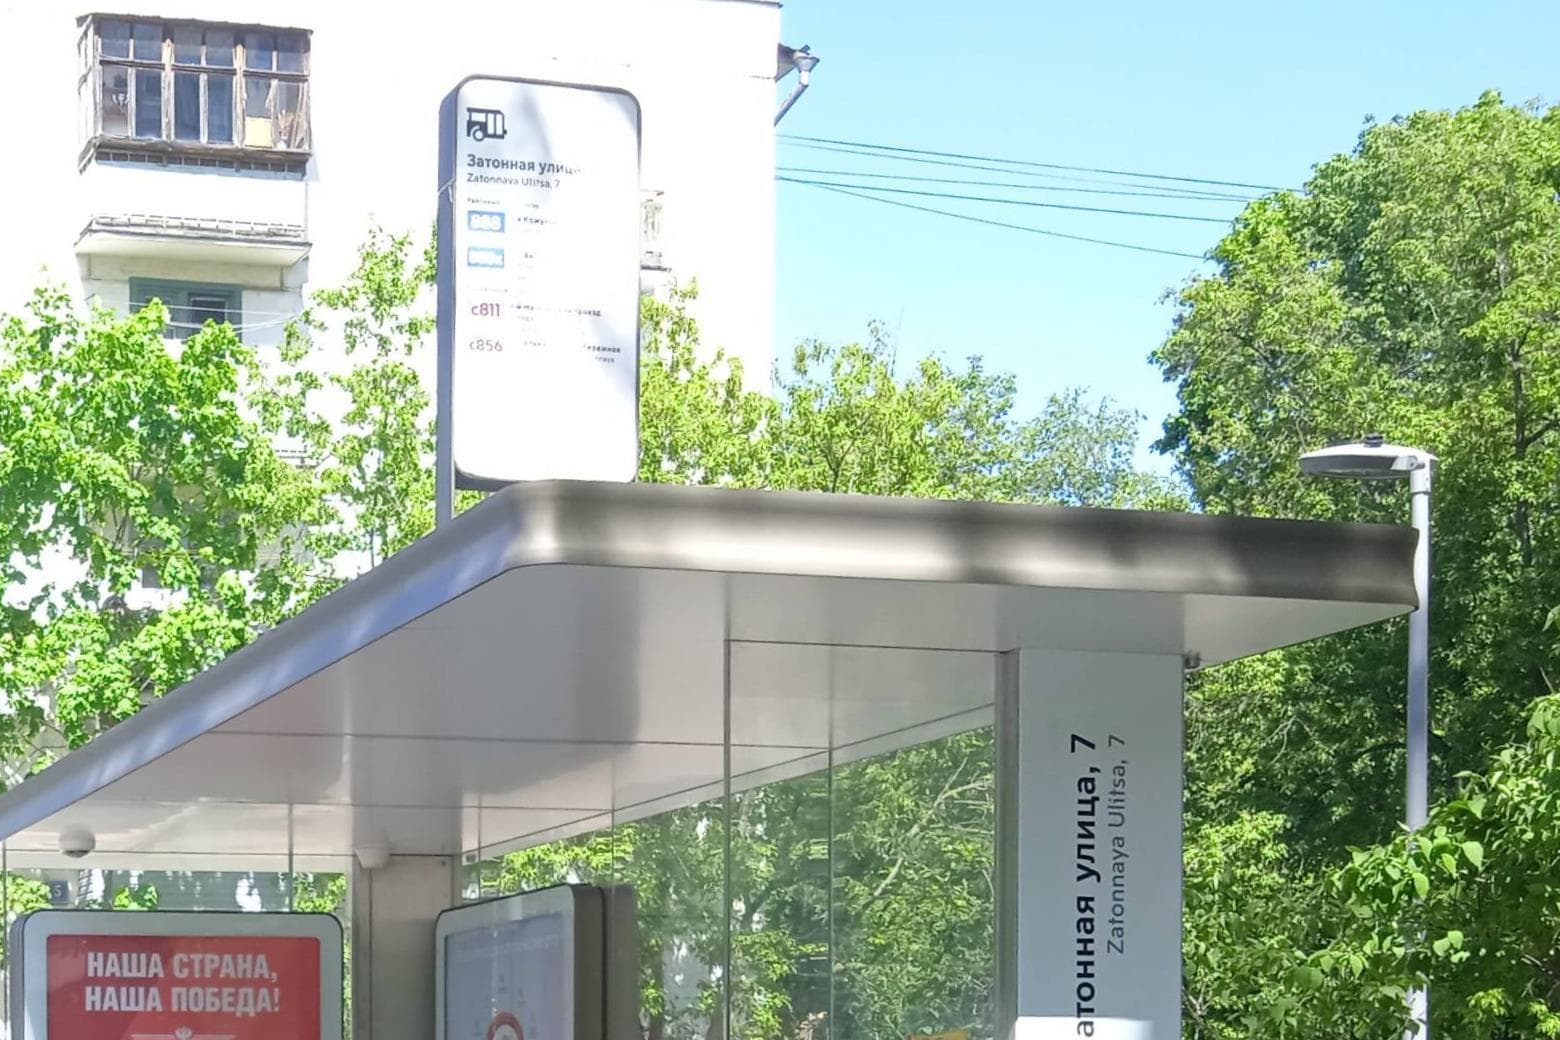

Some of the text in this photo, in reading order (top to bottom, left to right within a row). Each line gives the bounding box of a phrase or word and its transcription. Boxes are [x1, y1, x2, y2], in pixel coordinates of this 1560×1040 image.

[467, 154, 581, 175] Затонная улиц
[1070, 733, 1096, 753] 7
[1076, 766, 1101, 883] улица,
[1107, 734, 1129, 954] Zatonnaya Ulitsa, 7
[87, 952, 278, 982] НАША СТРАНА,
[85, 986, 280, 1017] НАША ПОБЕДА!
